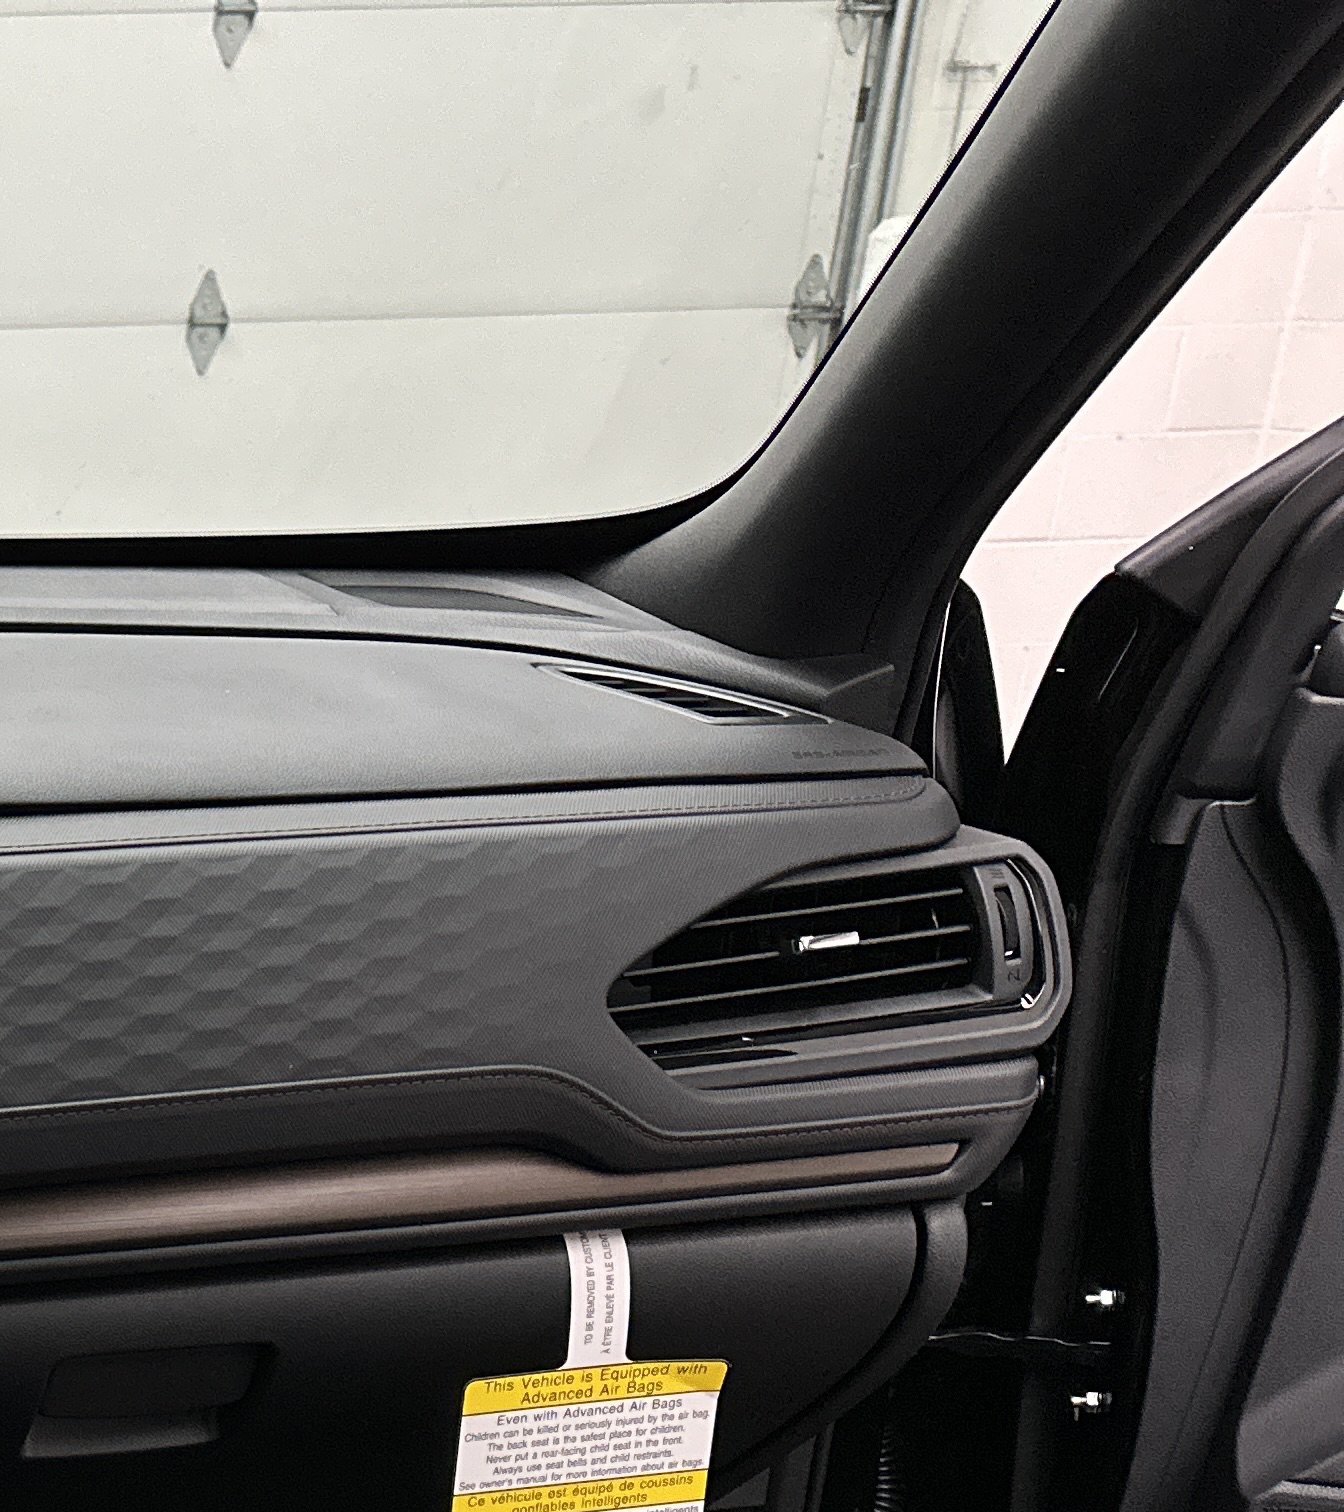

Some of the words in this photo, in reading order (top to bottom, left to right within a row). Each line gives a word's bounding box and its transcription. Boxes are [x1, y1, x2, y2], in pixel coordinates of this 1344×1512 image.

[598, 1233, 613, 1259] CLIENT
[586, 1267, 595, 1278] BY
[605, 1262, 615, 1273] LE
[605, 1274, 615, 1291] PAR
[586, 1280, 595, 1319] REMOVED
[605, 1294, 615, 1324] ENLEVÉ
[585, 1320, 594, 1332] BE
[602, 1326, 613, 1347] ÊTRE
[584, 1334, 594, 1345] TO
[484, 1381, 514, 1394] This
[521, 1373, 575, 1389] Vehicle
[580, 1371, 593, 1382] is
[600, 1364, 670, 1382] Equipped
[676, 1364, 708, 1375] with
[520, 1386, 594, 1405] Advanced
[599, 1384, 621, 1397] Air
[626, 1380, 663, 1395] Bags
[497, 1415, 528, 1426] Even
[533, 1410, 558, 1422] with
[563, 1402, 624, 1419] Advanced
[629, 1401, 647, 1412] Air
[652, 1398, 683, 1410] Bags
[464, 1431, 500, 1443] Children
[503, 1429, 519, 1438] can
[522, 1427, 534, 1436] be
[537, 1424, 559, 1434] killed
[574, 1418, 612, 1431] seriously
[615, 1415, 645, 1428] injured
[648, 1414, 658, 1425] by
[661, 1412, 675, 1421] the
[678, 1410, 689, 1420] air
[488, 1443, 504, 1452] The
[507, 1440, 528, 1450] back
[531, 1438, 550, 1447] seat
[552, 1436, 560, 1445] is
[563, 1435, 577, 1444] the
[581, 1432, 606, 1442] safest
[609, 1428, 632, 1440] place
[635, 1428, 648, 1436] for
[650, 1424, 685, 1434] children.
[486, 1453, 512, 1464] Never
[515, 1452, 529, 1463] put
[541, 1446, 587, 1458] rear-facing
[590, 1442, 609, 1453] child
[613, 1440, 632, 1451] seat
[634, 1440, 642, 1448] in
[646, 1438, 659, 1447] the
[492, 1464, 523, 1476] Always
[526, 1463, 542, 1472] use
[545, 1460, 564, 1470] seat
[567, 1457, 587, 1467] belts
[591, 1455, 607, 1466] and
[610, 1452, 630, 1463] child
[458, 1481, 476, 1491] See
[479, 1478, 513, 1489] owner's
[516, 1473, 548, 1485] manual
[551, 1472, 563, 1481] for
[565, 1470, 588, 1479] more
[590, 1464, 638, 1478] information
[641, 1462, 665, 1472] about
[668, 1460, 678, 1468] air
[467, 1496, 486, 1508] Ce
[491, 1489, 543, 1505] véhicule
[548, 1487, 567, 1499] est
[572, 1481, 614, 1497] équipé
[619, 1480, 635, 1491] de
[639, 1474, 694, 1489] coussins
